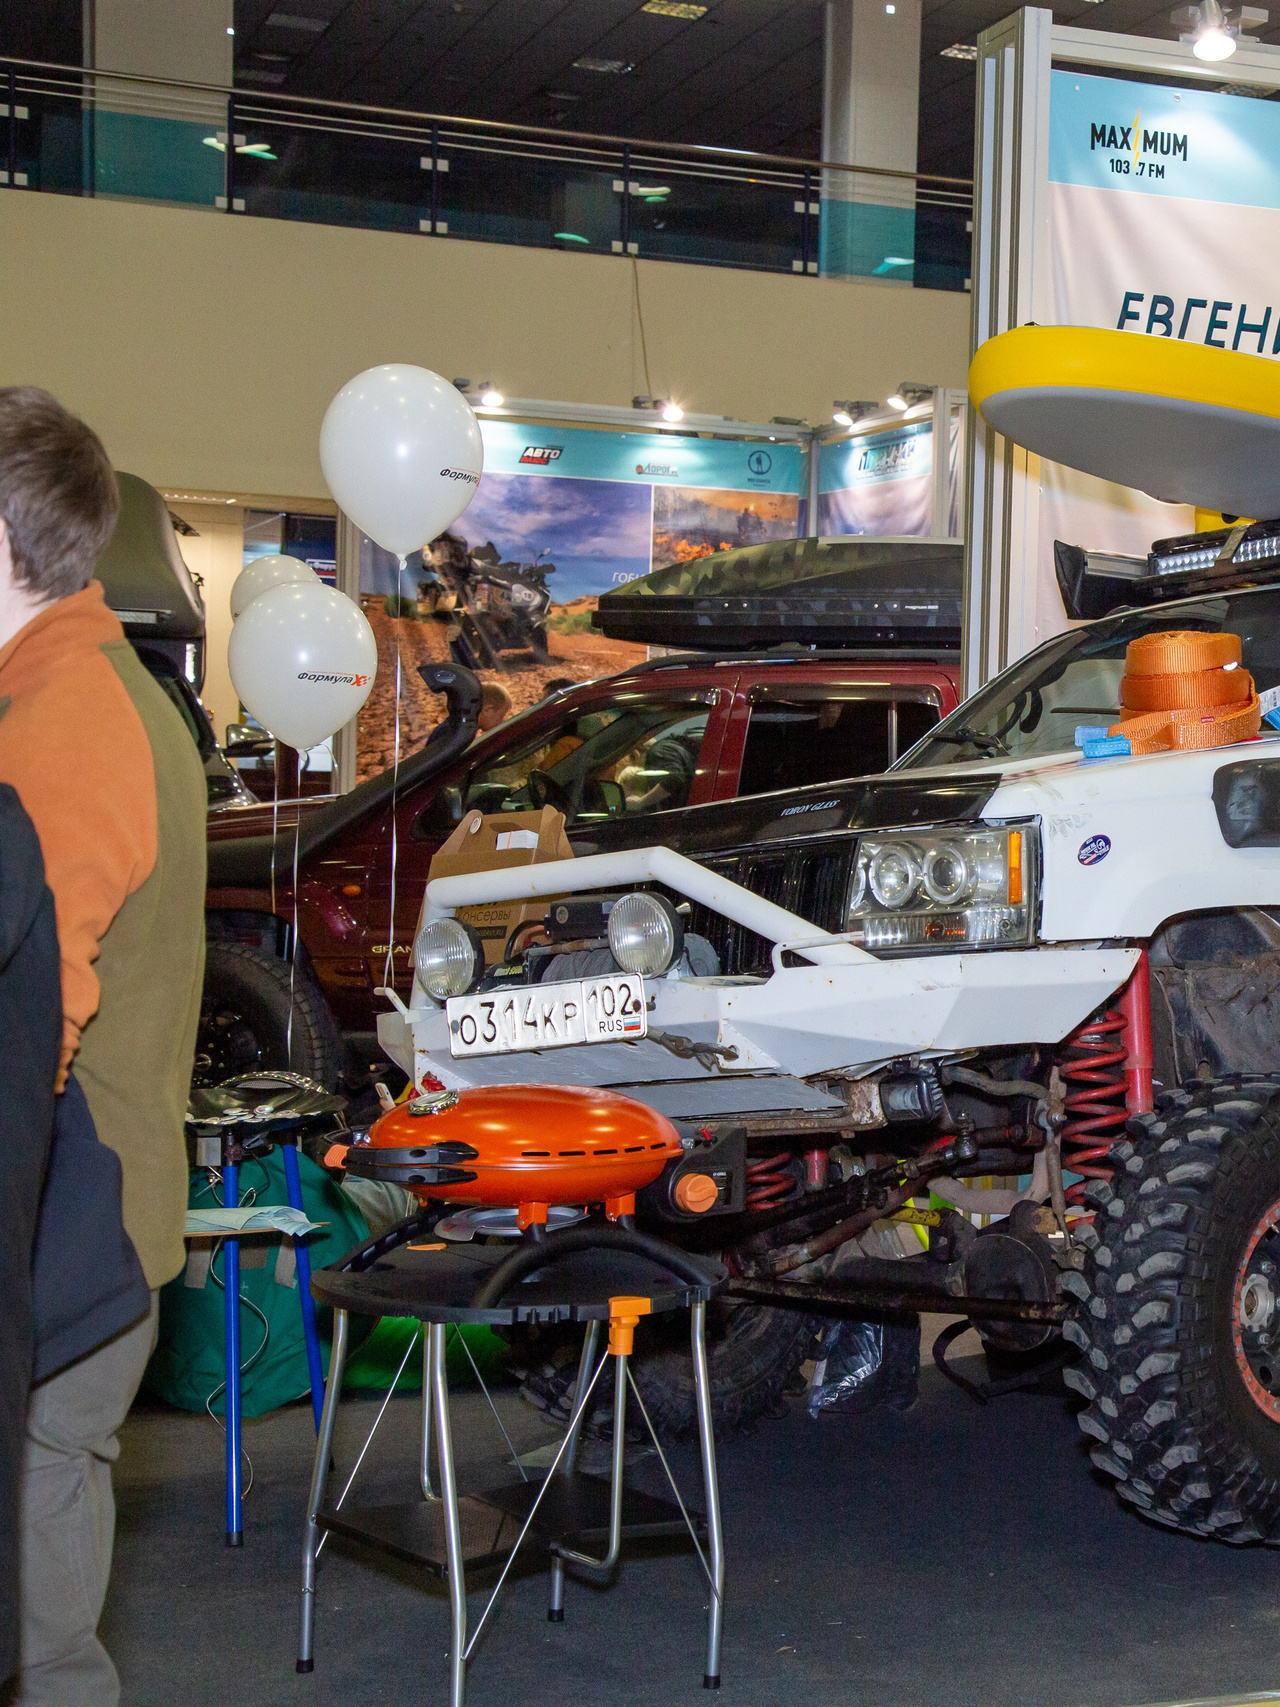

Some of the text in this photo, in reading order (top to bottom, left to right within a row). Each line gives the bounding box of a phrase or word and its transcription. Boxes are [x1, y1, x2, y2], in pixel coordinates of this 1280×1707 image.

[1091, 121, 1188, 161] MAXIMUM
[1148, 163, 1165, 179] FM
[523, 447, 561, 459] АВТО
[587, 983, 633, 1020] 102
[599, 1019, 623, 1033] RUS
